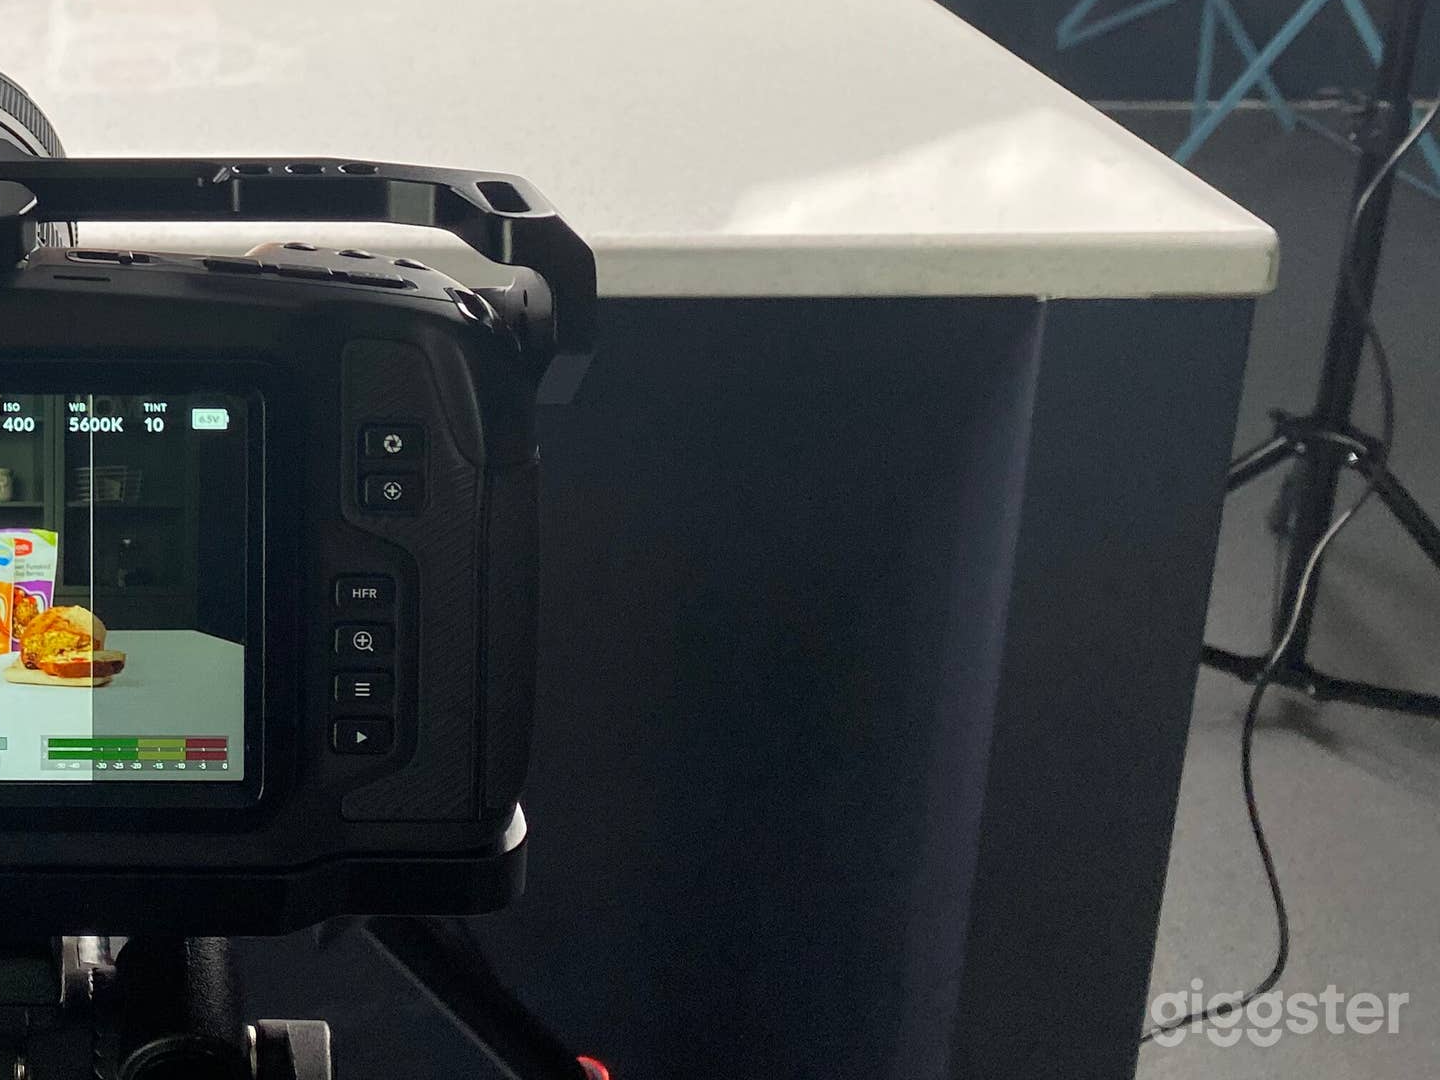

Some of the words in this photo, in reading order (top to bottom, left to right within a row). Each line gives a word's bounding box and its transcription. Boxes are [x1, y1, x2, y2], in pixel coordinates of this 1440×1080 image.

[3, 402, 20, 412] ISO
[68, 402, 86, 412] WB
[143, 402, 168, 412] TINT
[2, 417, 35, 432] 400
[68, 417, 124, 432] 5600K
[144, 417, 165, 432] 10
[352, 588, 377, 599] HFR
